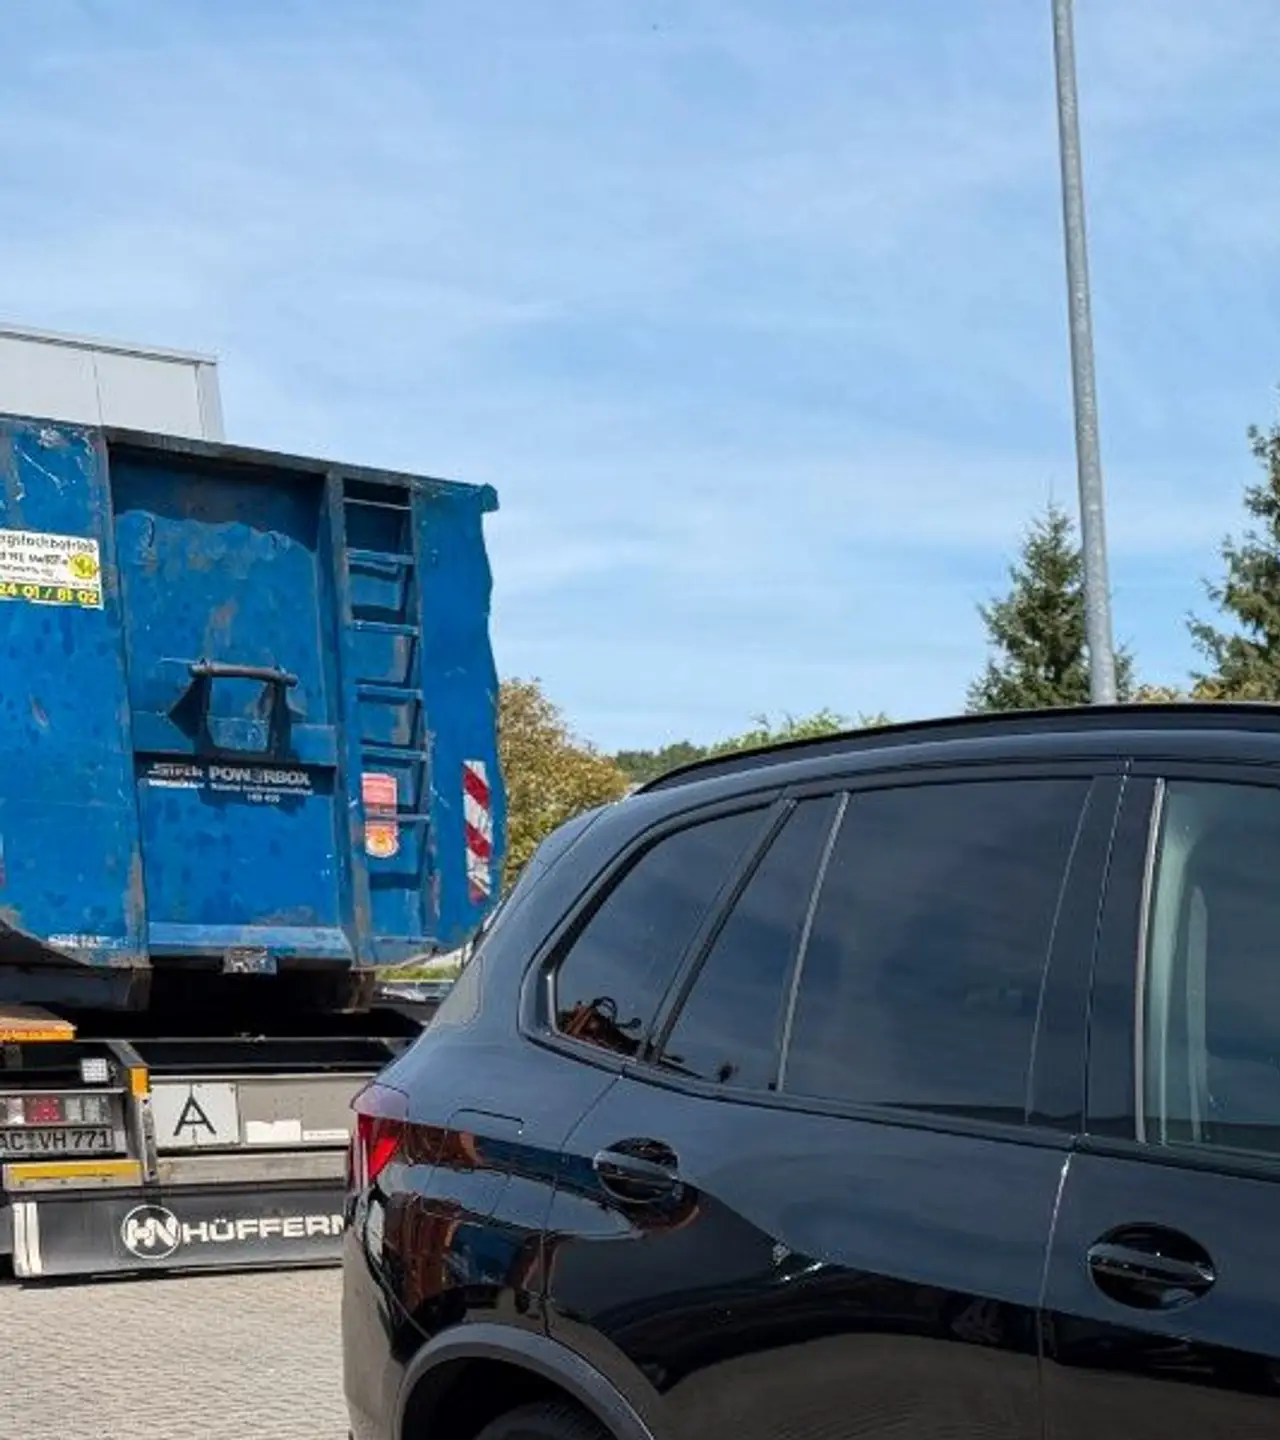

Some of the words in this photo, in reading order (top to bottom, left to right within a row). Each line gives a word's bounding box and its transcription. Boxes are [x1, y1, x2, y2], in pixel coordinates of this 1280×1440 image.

[208, 765, 312, 786] POWERBOX
[173, 1096, 217, 1137] A
[39, 1131, 66, 1149] VH
[71, 1130, 109, 1149] 771
